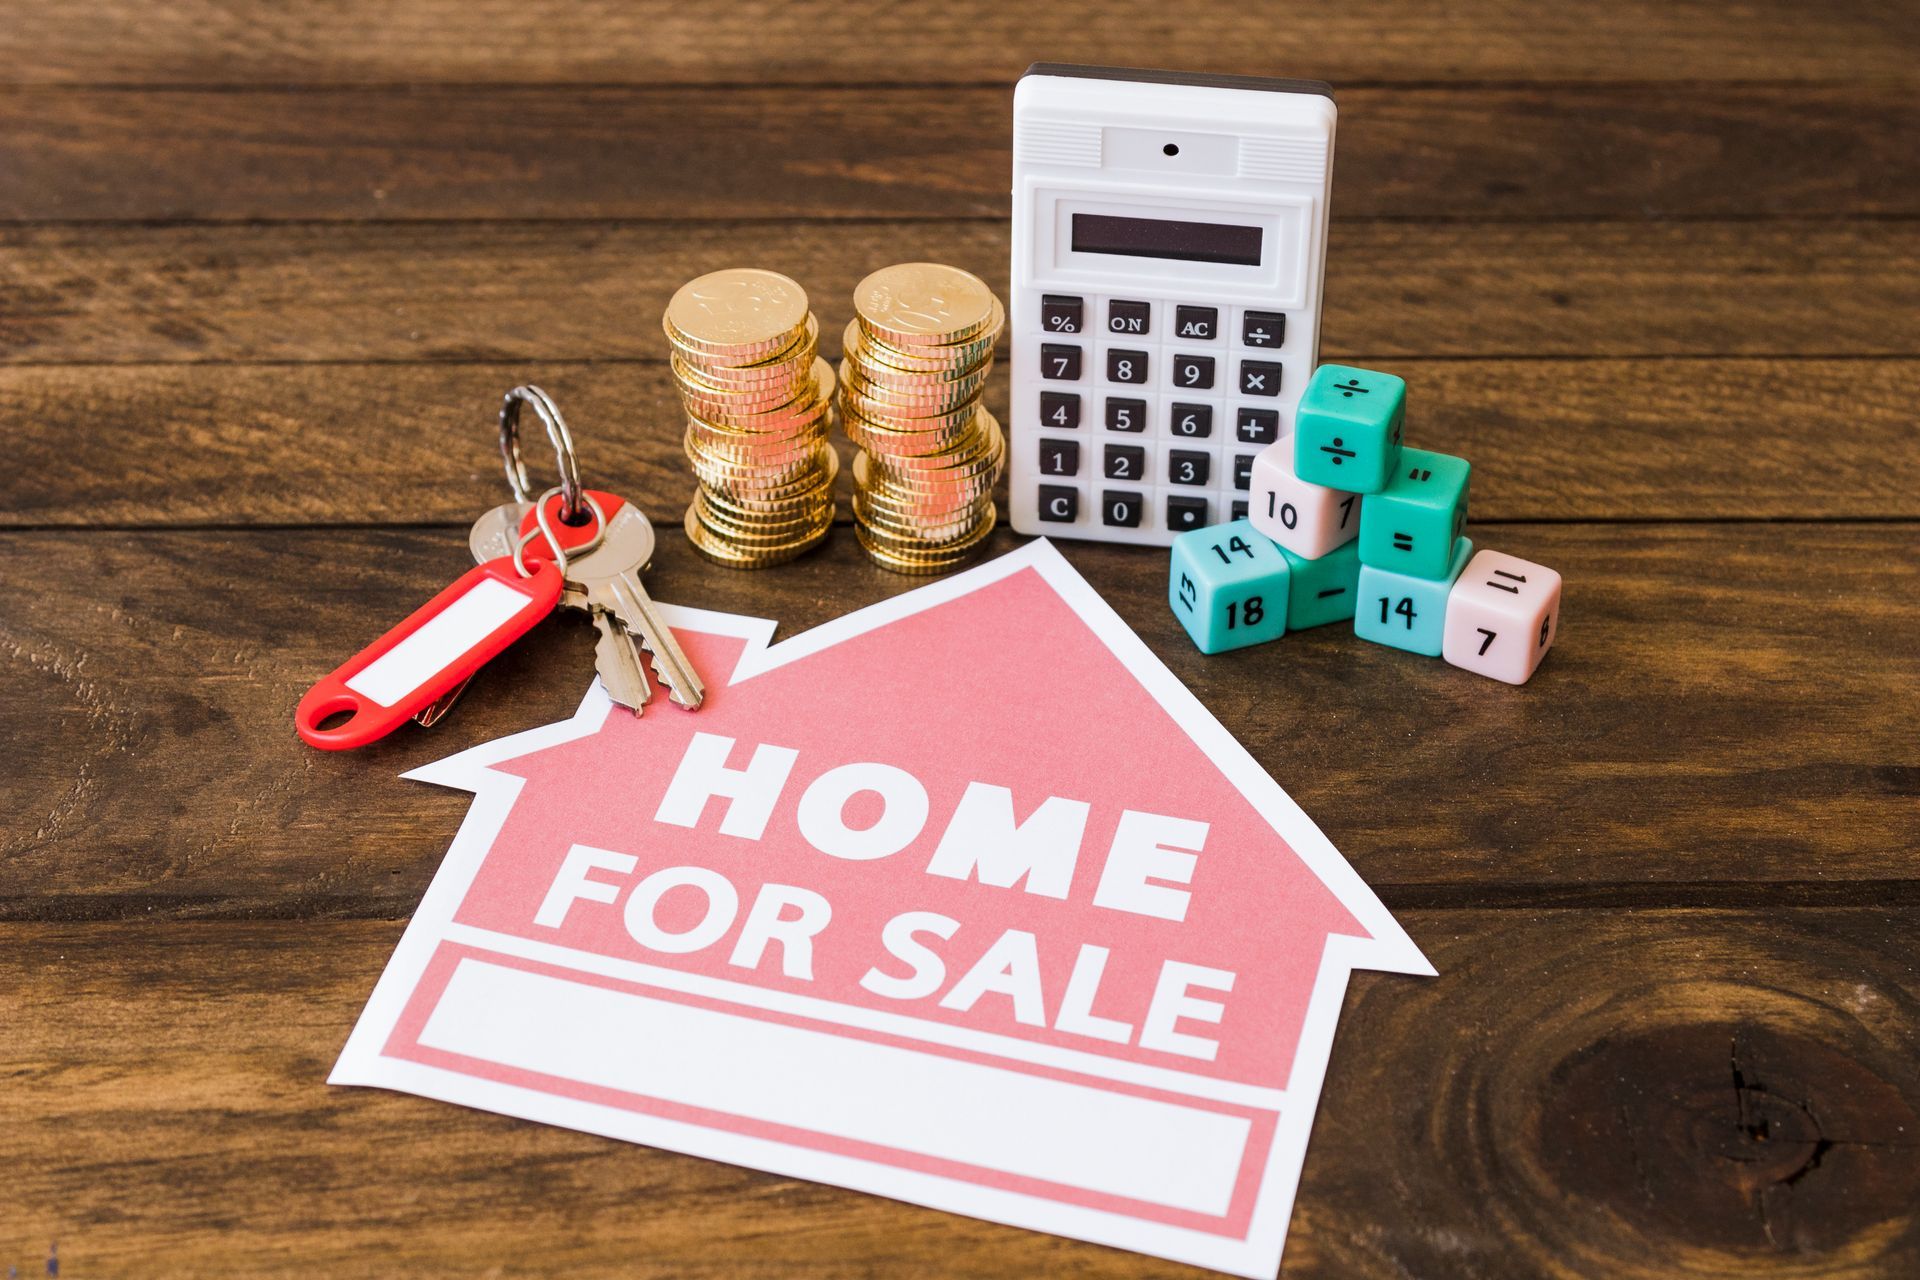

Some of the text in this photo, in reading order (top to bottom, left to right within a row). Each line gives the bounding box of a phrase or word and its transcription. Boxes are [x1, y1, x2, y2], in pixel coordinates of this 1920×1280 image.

[1110, 316, 1142, 332] ON
[1180, 321, 1208, 336] AC
[1053, 357, 1069, 377] 7
[1117, 360, 1133, 381] 8
[1184, 364, 1200, 385] 9
[1052, 405, 1068, 425] 4
[1116, 409, 1131, 431] 5
[1181, 414, 1197, 434] 6
[1053, 452, 1195, 482] 1 2 3
[1050, 497, 1128, 522] C 0
[1266, 490, 1298, 530] 10
[1211, 535, 1255, 565] 14
[1178, 572, 1197, 613] 13
[1225, 595, 1264, 630] 18
[1378, 596, 1418, 630] 14
[1476, 627, 1497, 657] 7
[654, 731, 1210, 923] HOME
[533, 843, 1236, 1062] FOR SALE
